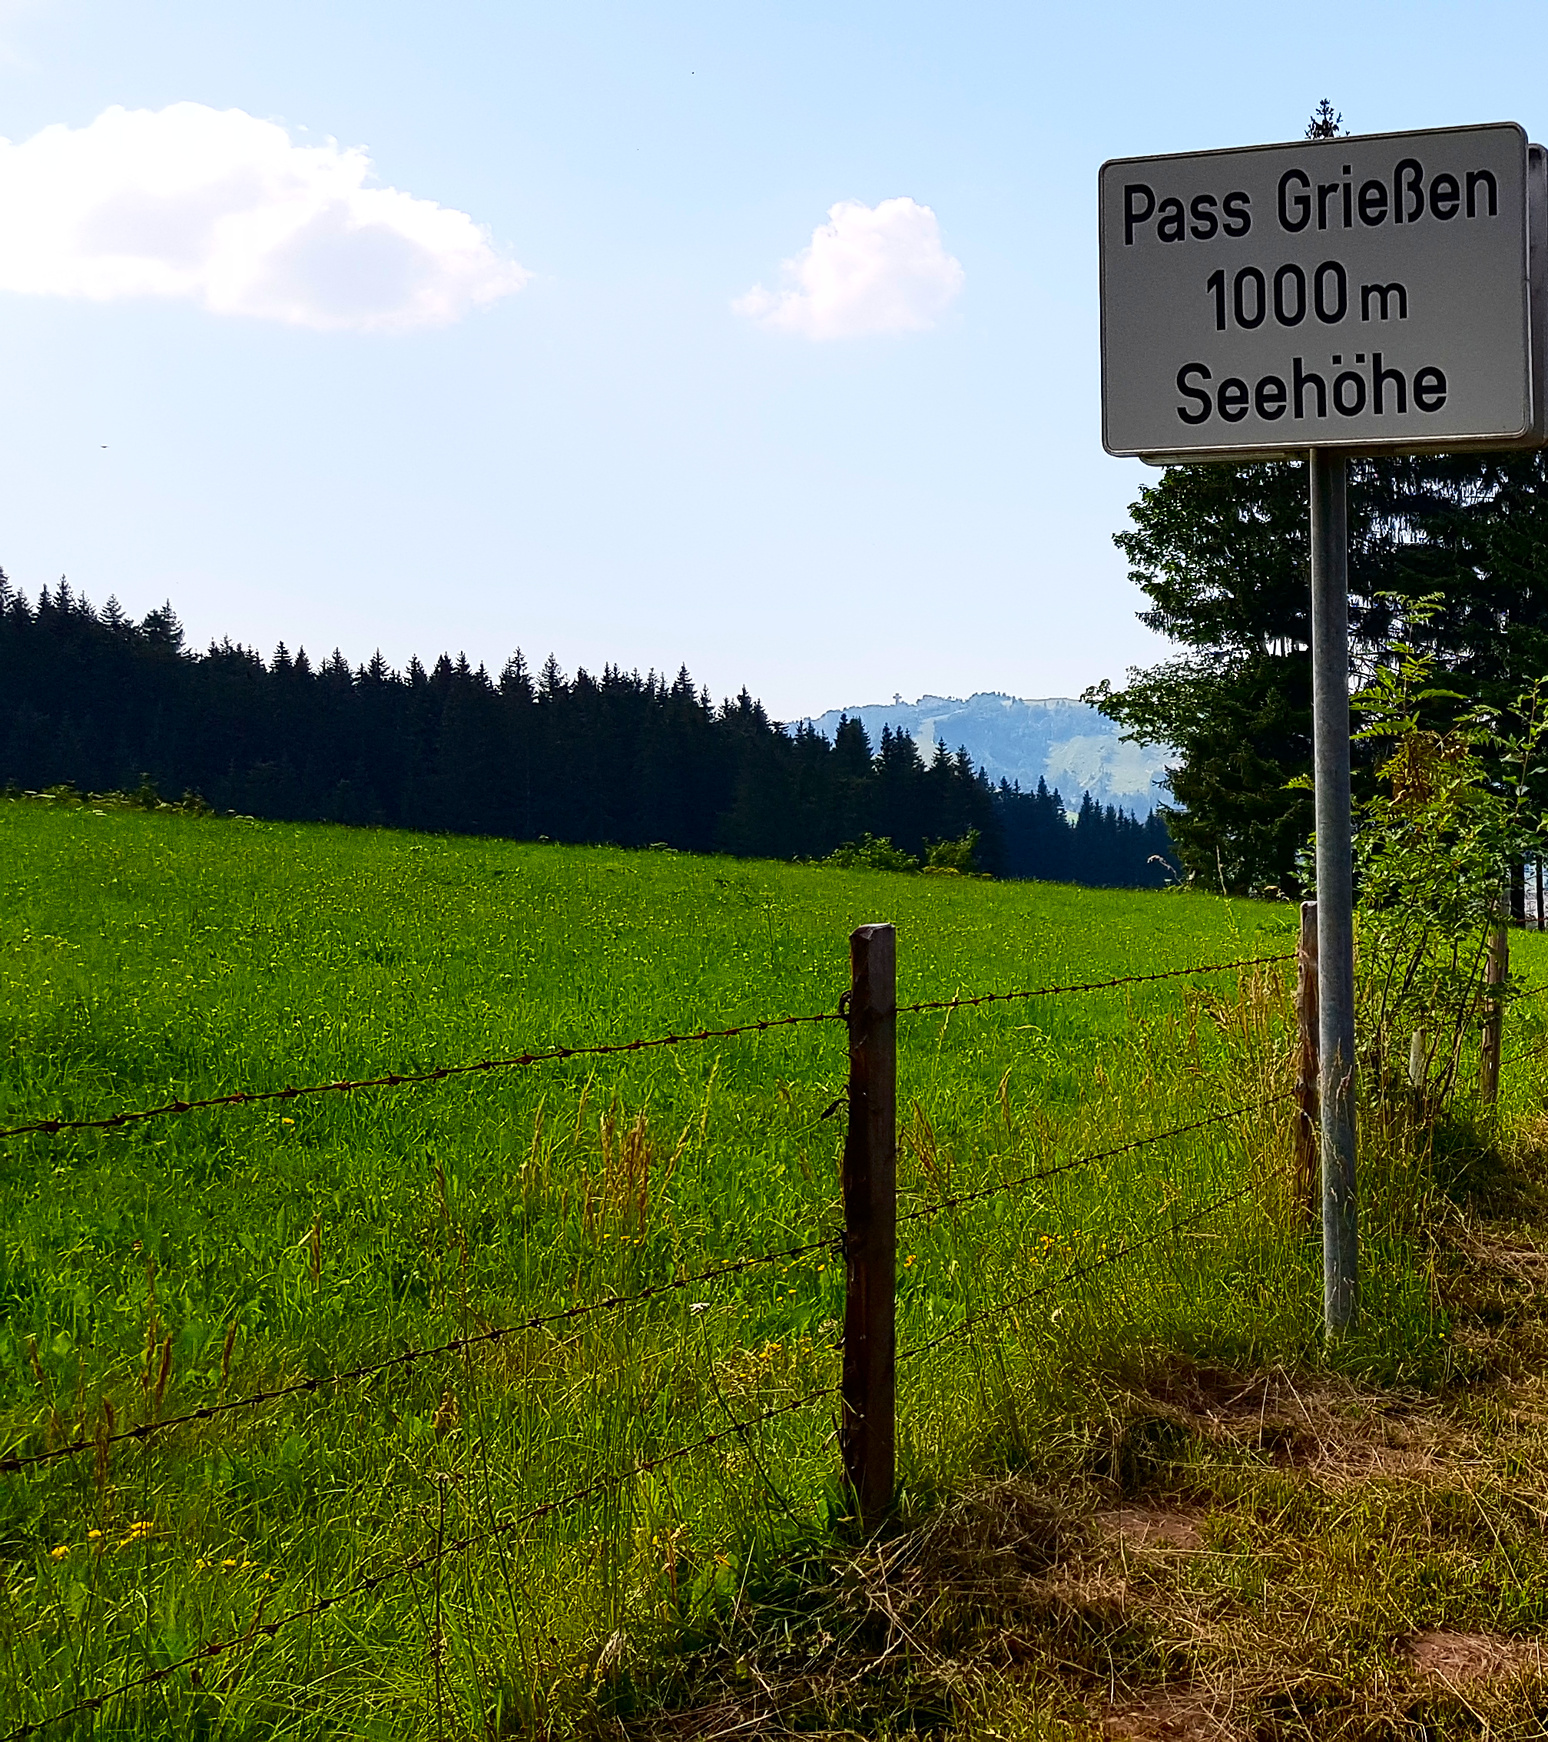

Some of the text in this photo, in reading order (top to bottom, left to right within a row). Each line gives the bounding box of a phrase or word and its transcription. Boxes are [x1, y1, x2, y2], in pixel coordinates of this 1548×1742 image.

[1124, 158, 1497, 245] Pass Grießen
[1206, 260, 1408, 331] 1000 m
[1176, 352, 1447, 424] Seehöhe
